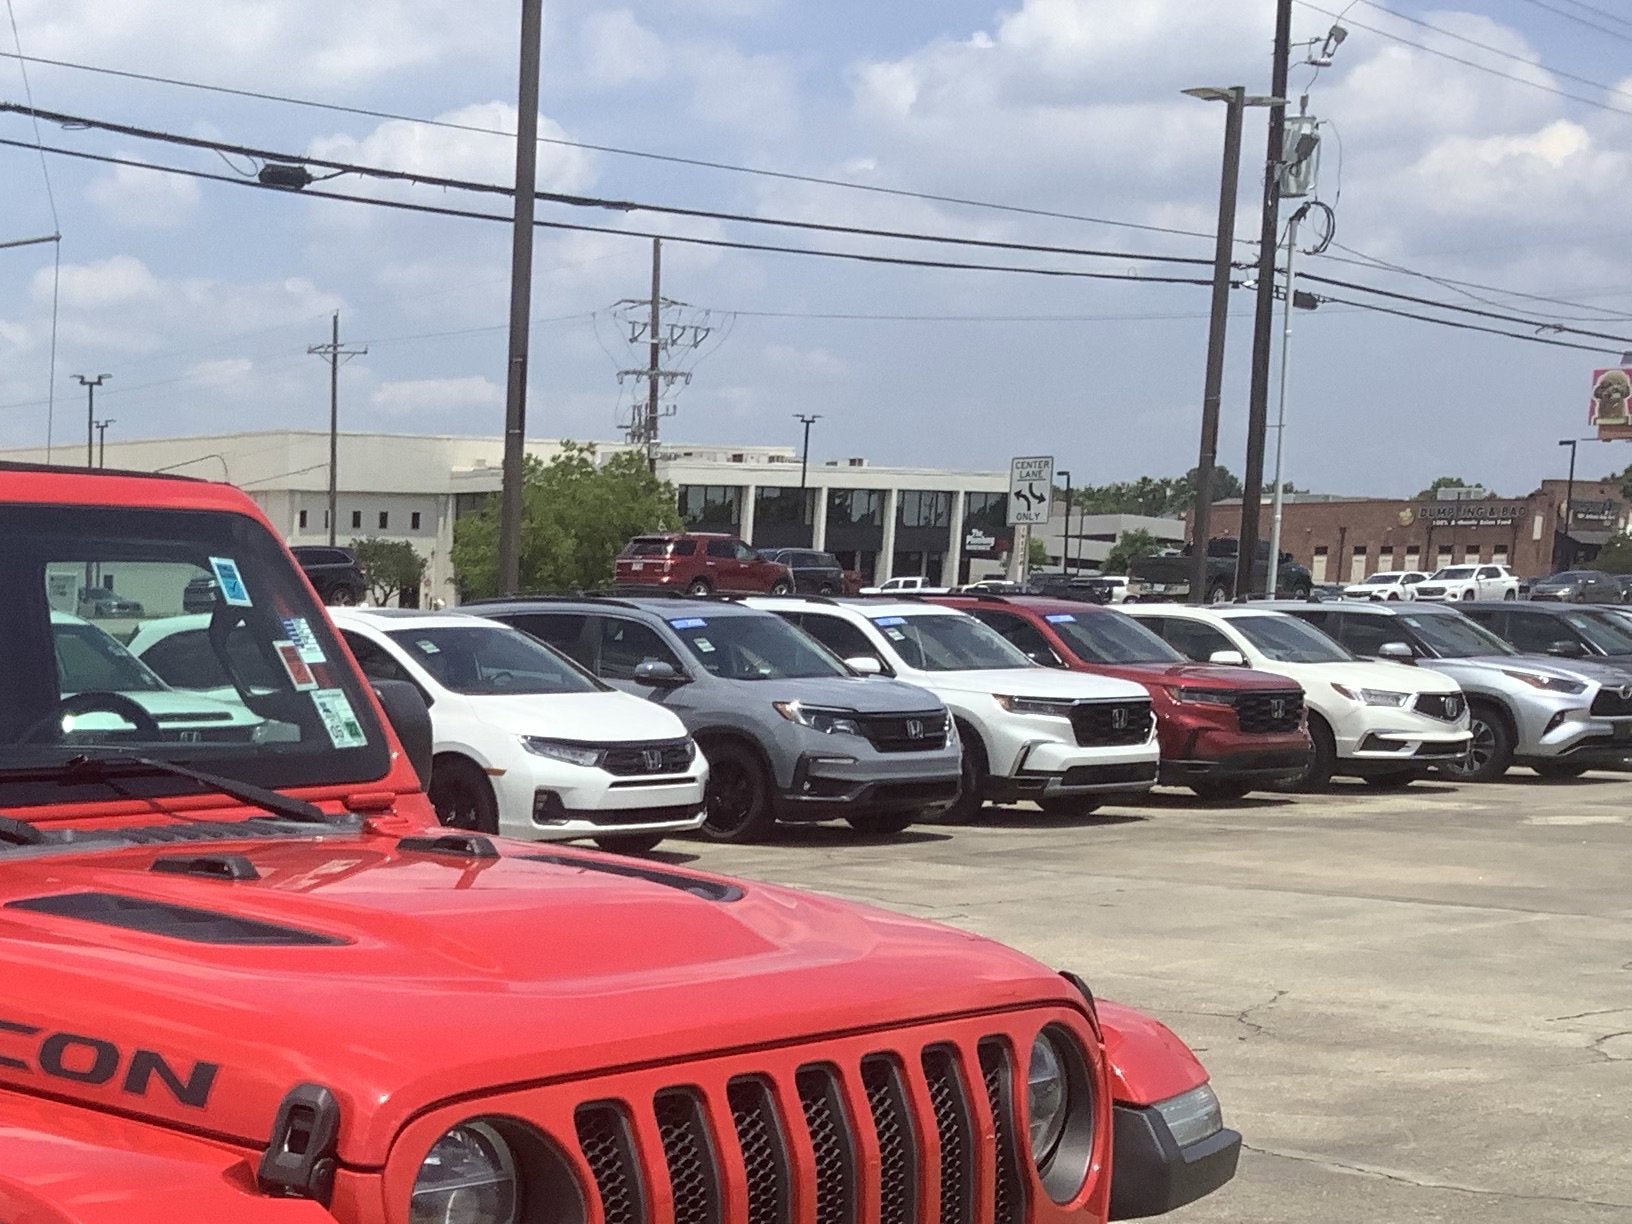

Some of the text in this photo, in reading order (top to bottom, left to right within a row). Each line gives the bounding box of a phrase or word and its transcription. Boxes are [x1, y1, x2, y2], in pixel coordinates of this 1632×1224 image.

[1015, 460, 1049, 470] CENTER
[1019, 470, 1043, 478] LANE
[1016, 512, 1041, 521] ONLY
